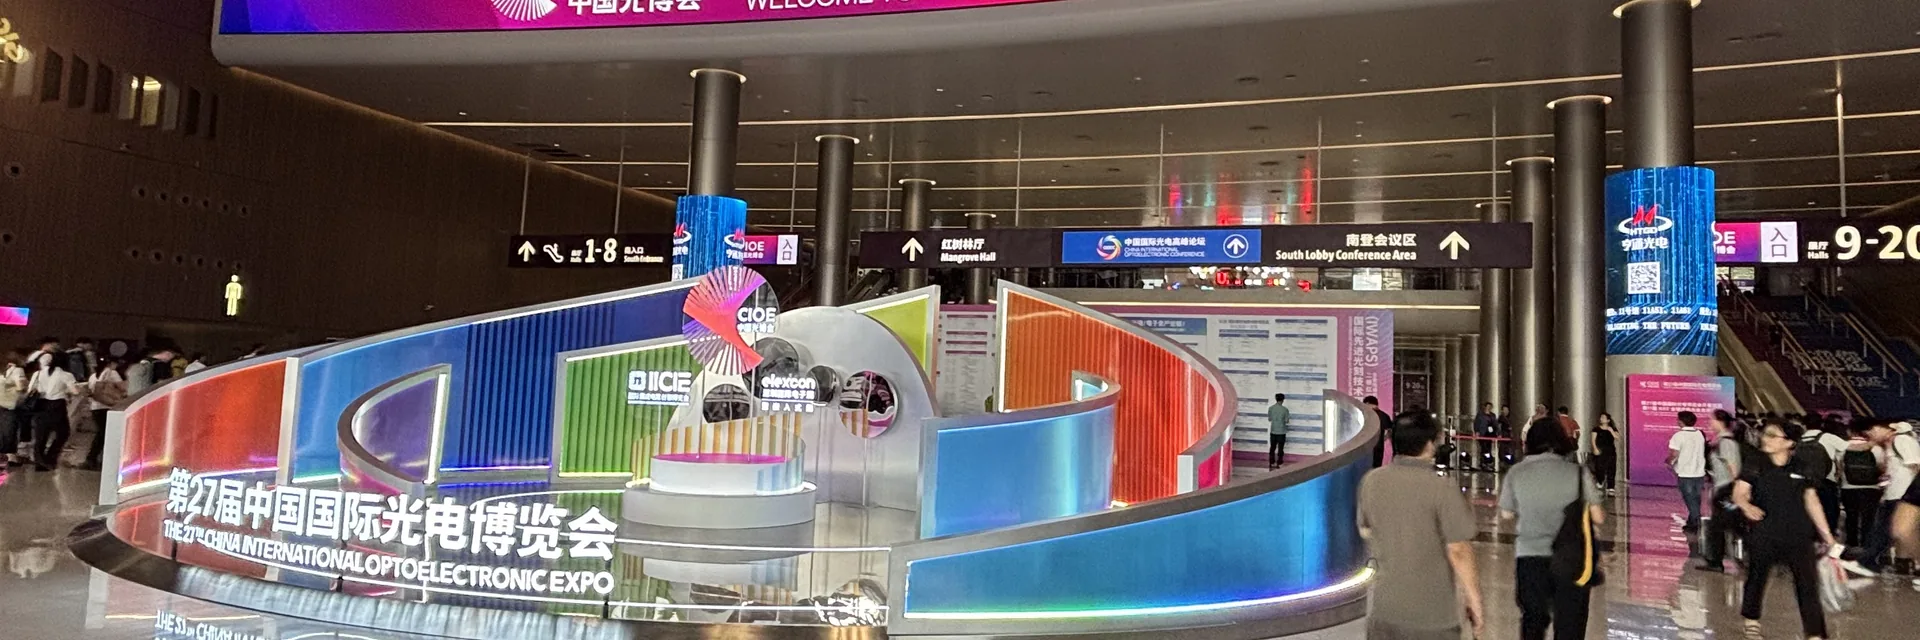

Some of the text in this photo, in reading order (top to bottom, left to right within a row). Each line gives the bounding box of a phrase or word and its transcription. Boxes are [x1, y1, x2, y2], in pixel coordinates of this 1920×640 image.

[744, 241, 764, 251] IOE
[941, 238, 985, 250] 红树林厅
[1124, 237, 1205, 246] 中国国际光电高峰论坛
[1346, 233, 1417, 246] 南登会议区
[1770, 228, 1788, 258] 入口
[585, 238, 617, 263] 1-8
[783, 239, 792, 260] 入口
[1276, 249, 1417, 262] South Lobby Conference Area
[941, 252, 996, 264] Mangrove Hall
[737, 307, 777, 322] CIOE
[1365, 316, 1379, 367] (IWAPS)
[761, 373, 816, 389] elexcon
[166, 468, 619, 561] 第27届中国国际光电博览会
[164, 519, 184, 542] THE
[204, 528, 240, 553] CHINA
[242, 535, 365, 573] INTERNATIONAL
[365, 554, 548, 592] OPTOELECTRONIC
[549, 570, 614, 595] EXPO
